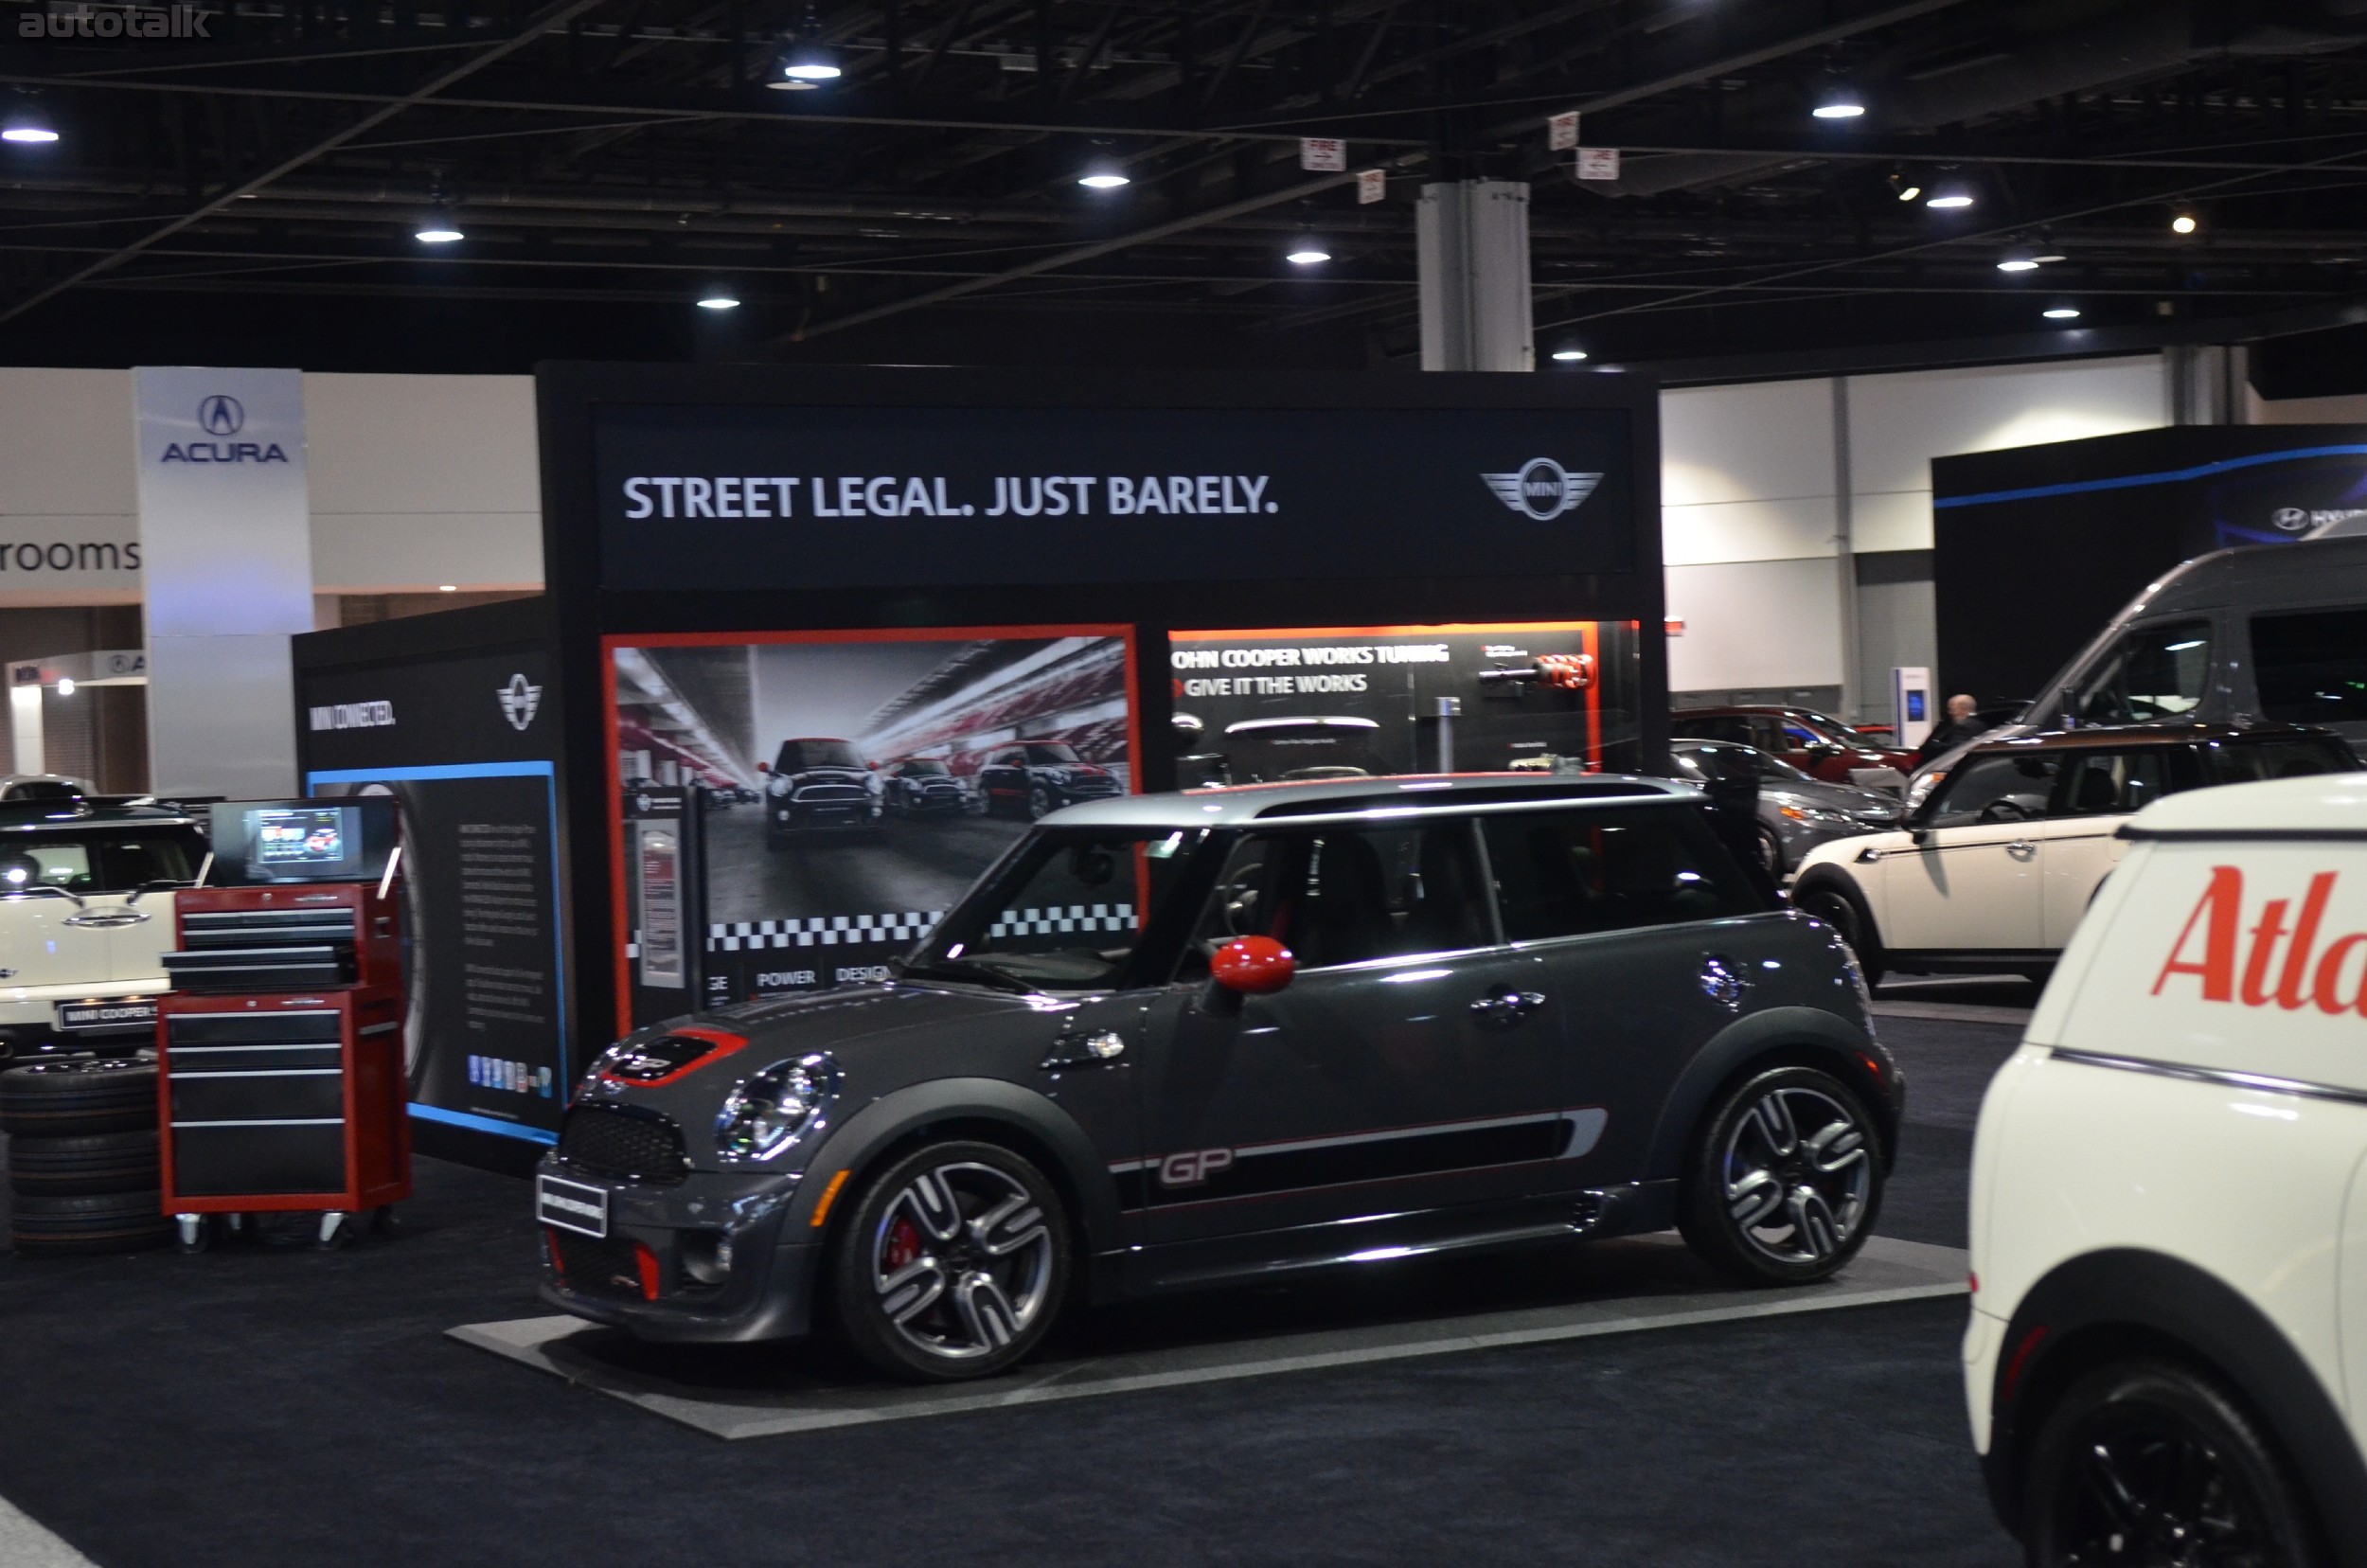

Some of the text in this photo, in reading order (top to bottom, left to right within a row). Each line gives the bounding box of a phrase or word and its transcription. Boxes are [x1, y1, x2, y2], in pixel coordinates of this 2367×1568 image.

[161, 442, 289, 462] ACURA
[623, 475, 1279, 519] STREET LEGAL. JUST BARELY.
[1523, 481, 1563, 497] MINI
[0, 542, 141, 571] rooms
[1221, 649, 1301, 668] COOPER
[1301, 646, 1374, 666] WORKS
[1184, 674, 1367, 697] GIVE IT THE WORKS
[756, 970, 816, 987] POWER
[66, 1009, 98, 1022] MINI
[98, 1007, 151, 1019] COOPER
[1160, 1148, 1233, 1185] GP
